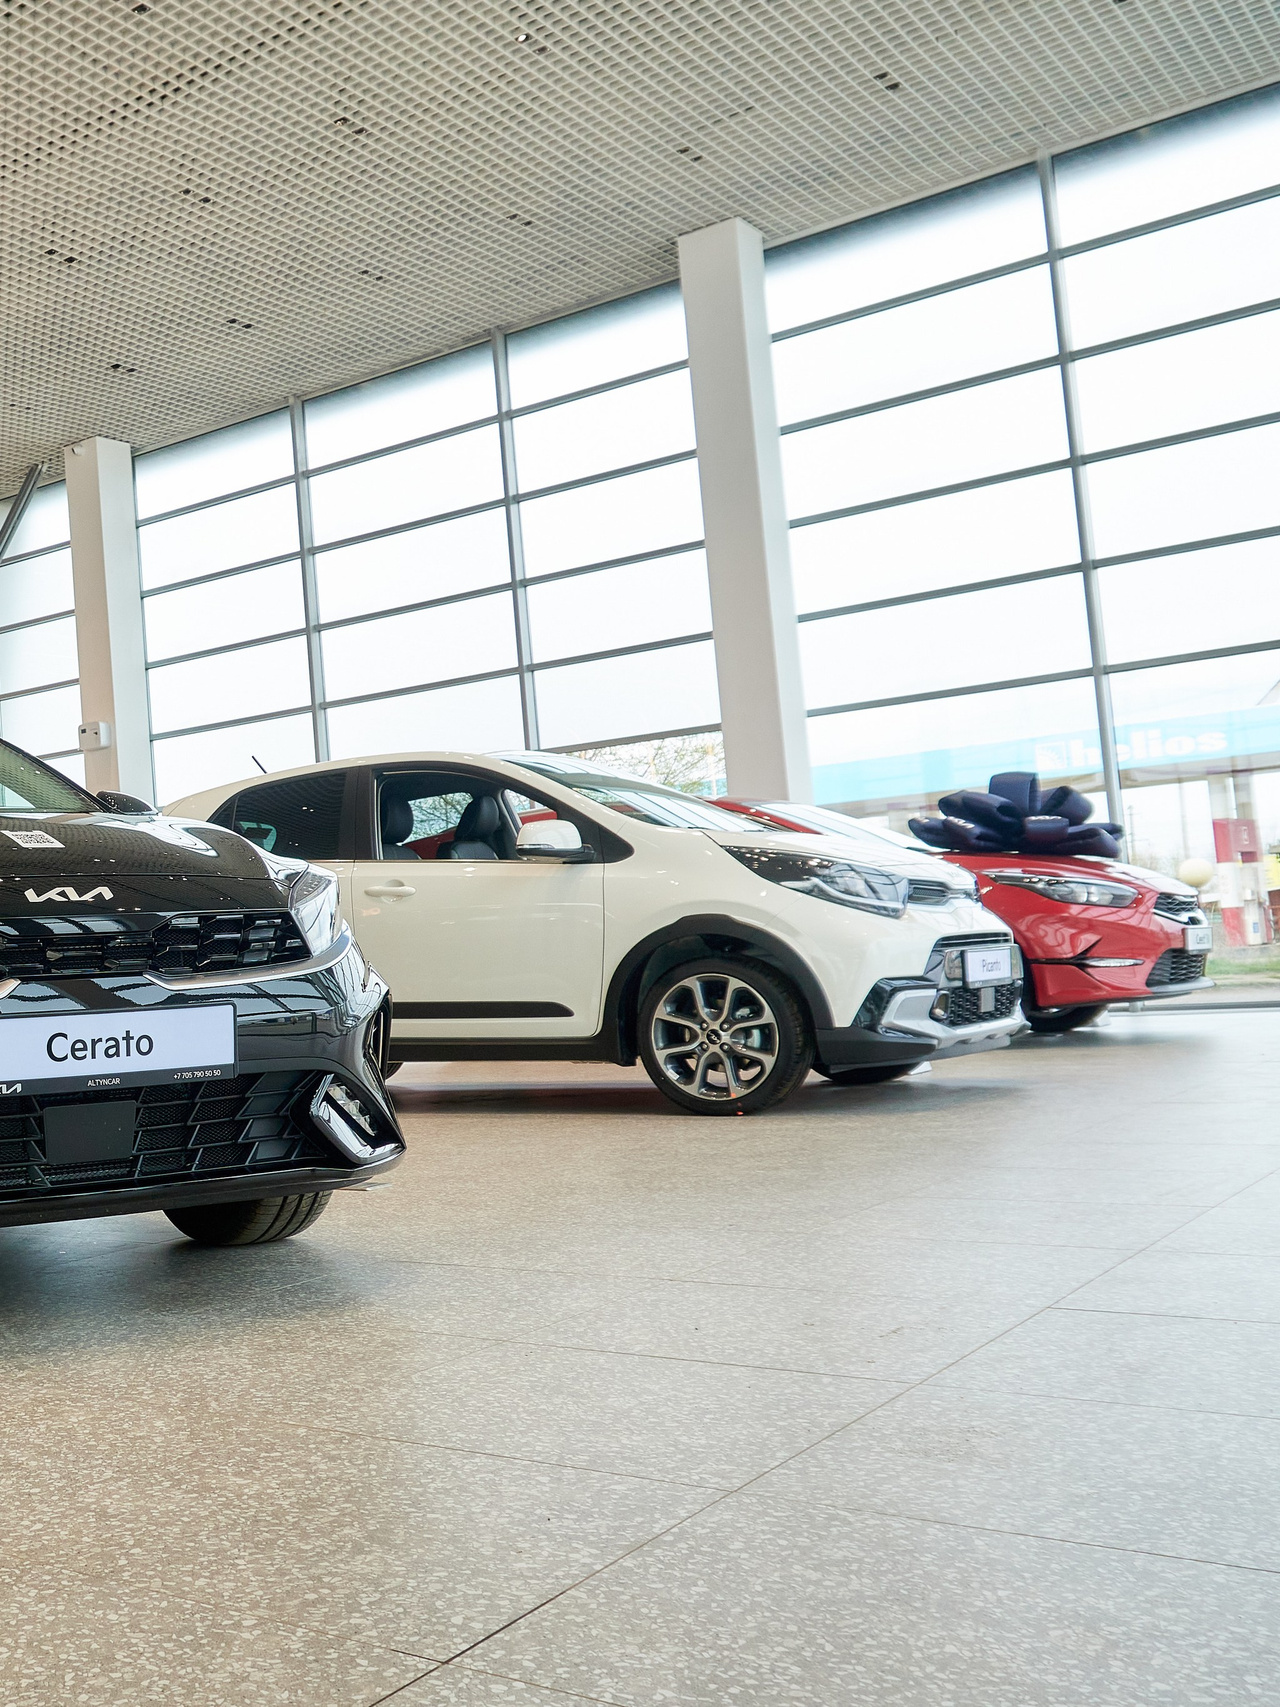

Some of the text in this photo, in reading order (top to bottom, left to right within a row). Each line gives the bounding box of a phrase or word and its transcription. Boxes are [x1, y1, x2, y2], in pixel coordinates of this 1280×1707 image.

[1072, 729, 1228, 767] helios
[24, 886, 114, 902] KIA
[46, 1030, 154, 1063] Cerato
[87, 1077, 121, 1087] ALTYNCAR
[173, 1072, 181, 1080] +7
[181, 1071, 192, 1079] 705
[193, 1070, 204, 1078] 790
